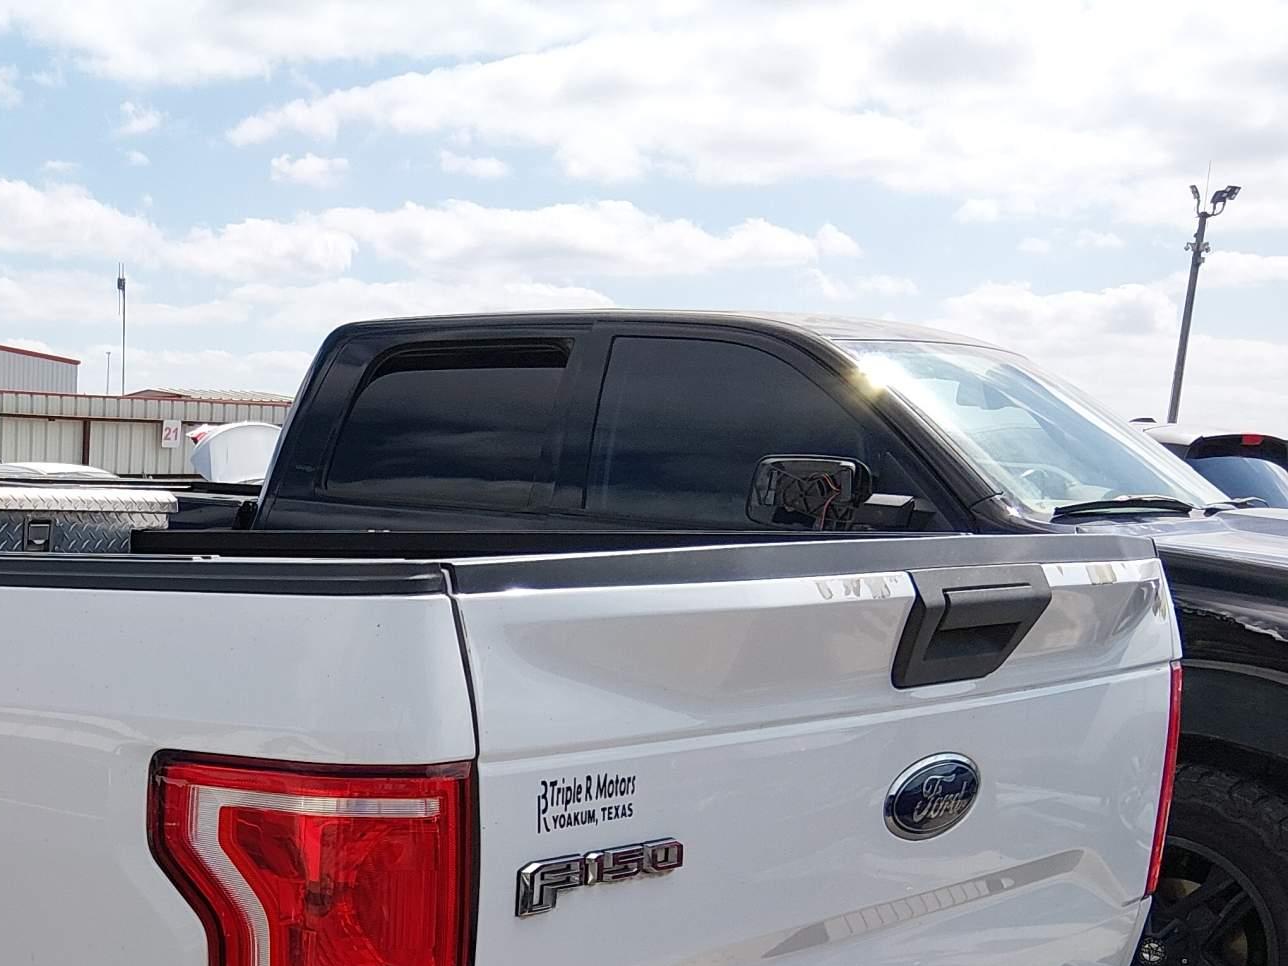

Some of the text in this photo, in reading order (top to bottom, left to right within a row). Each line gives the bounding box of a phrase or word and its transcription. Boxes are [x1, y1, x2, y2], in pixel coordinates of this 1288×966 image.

[164, 426, 179, 441] 21
[549, 773, 636, 812] Triple R Motors
[552, 802, 634, 830] YOAKUM, TEXAS
